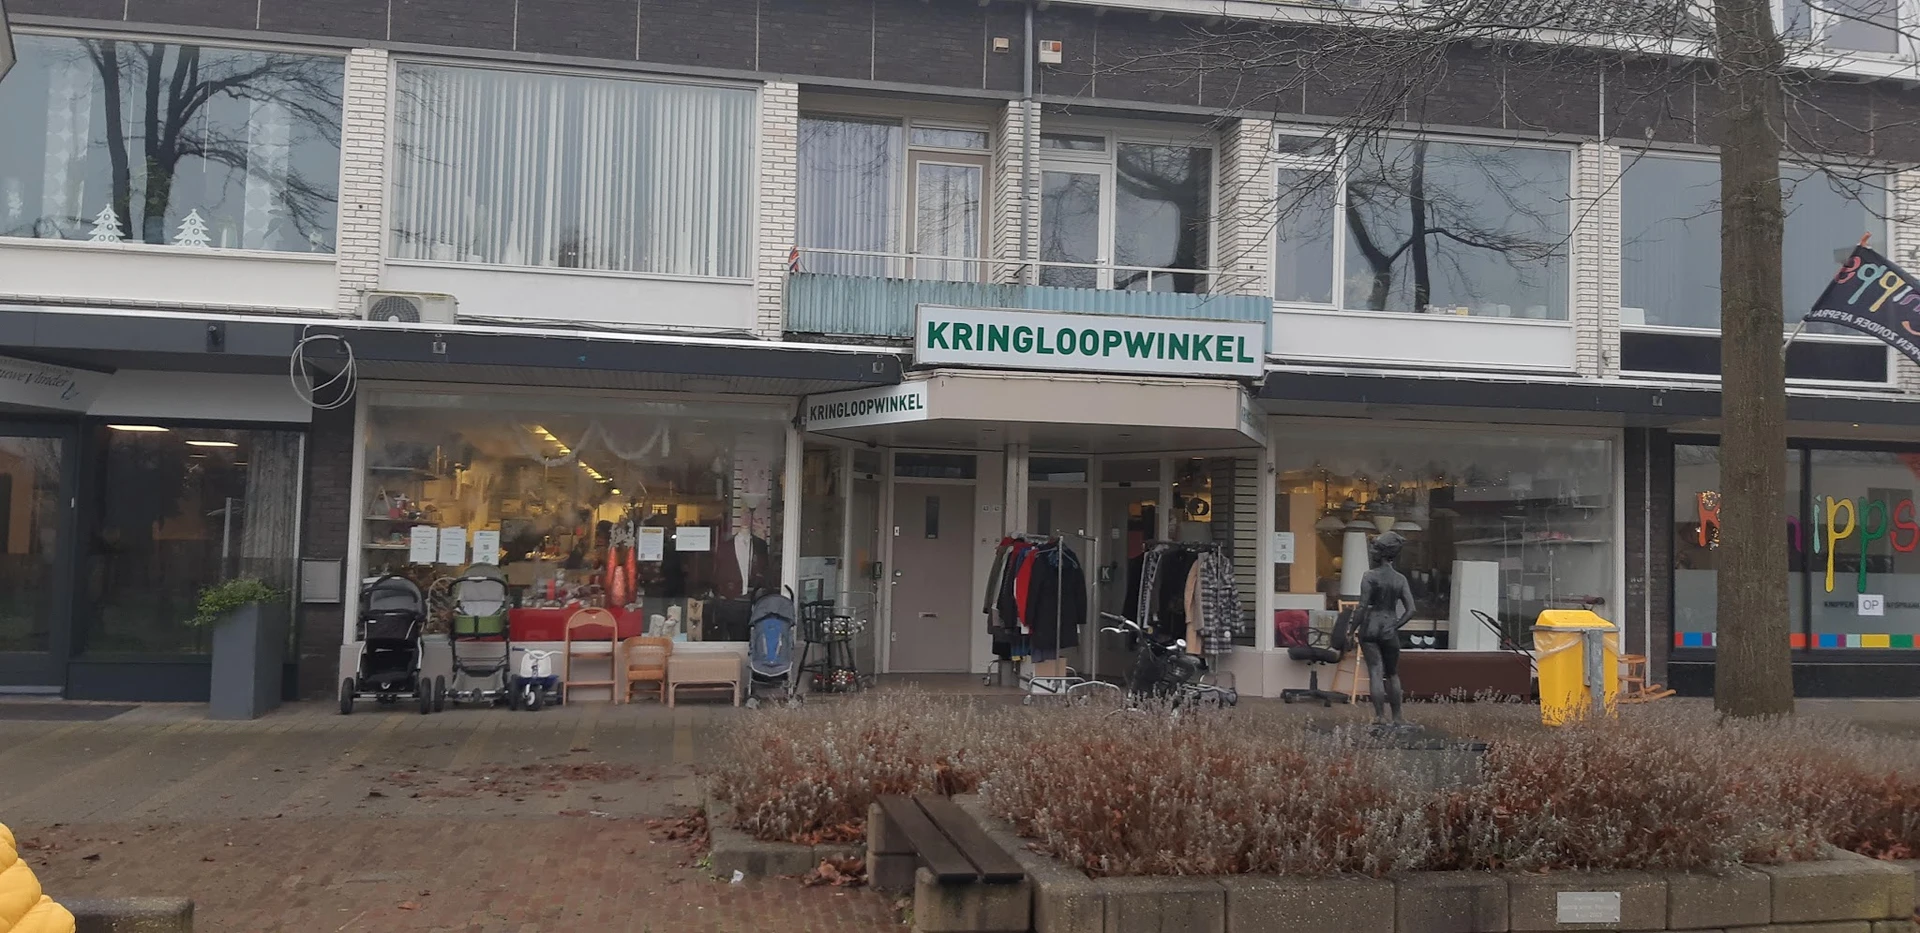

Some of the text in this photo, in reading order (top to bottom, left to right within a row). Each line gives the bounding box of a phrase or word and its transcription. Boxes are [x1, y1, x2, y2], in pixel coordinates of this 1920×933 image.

[927, 321, 1254, 363] KRINGLOOPWINKEL
[810, 393, 923, 421] KRINGLOOPWINKEL
[1696, 492, 1920, 593] Kipps
[1102, 567, 1110, 579] K
[1862, 600, 1880, 611] OP
